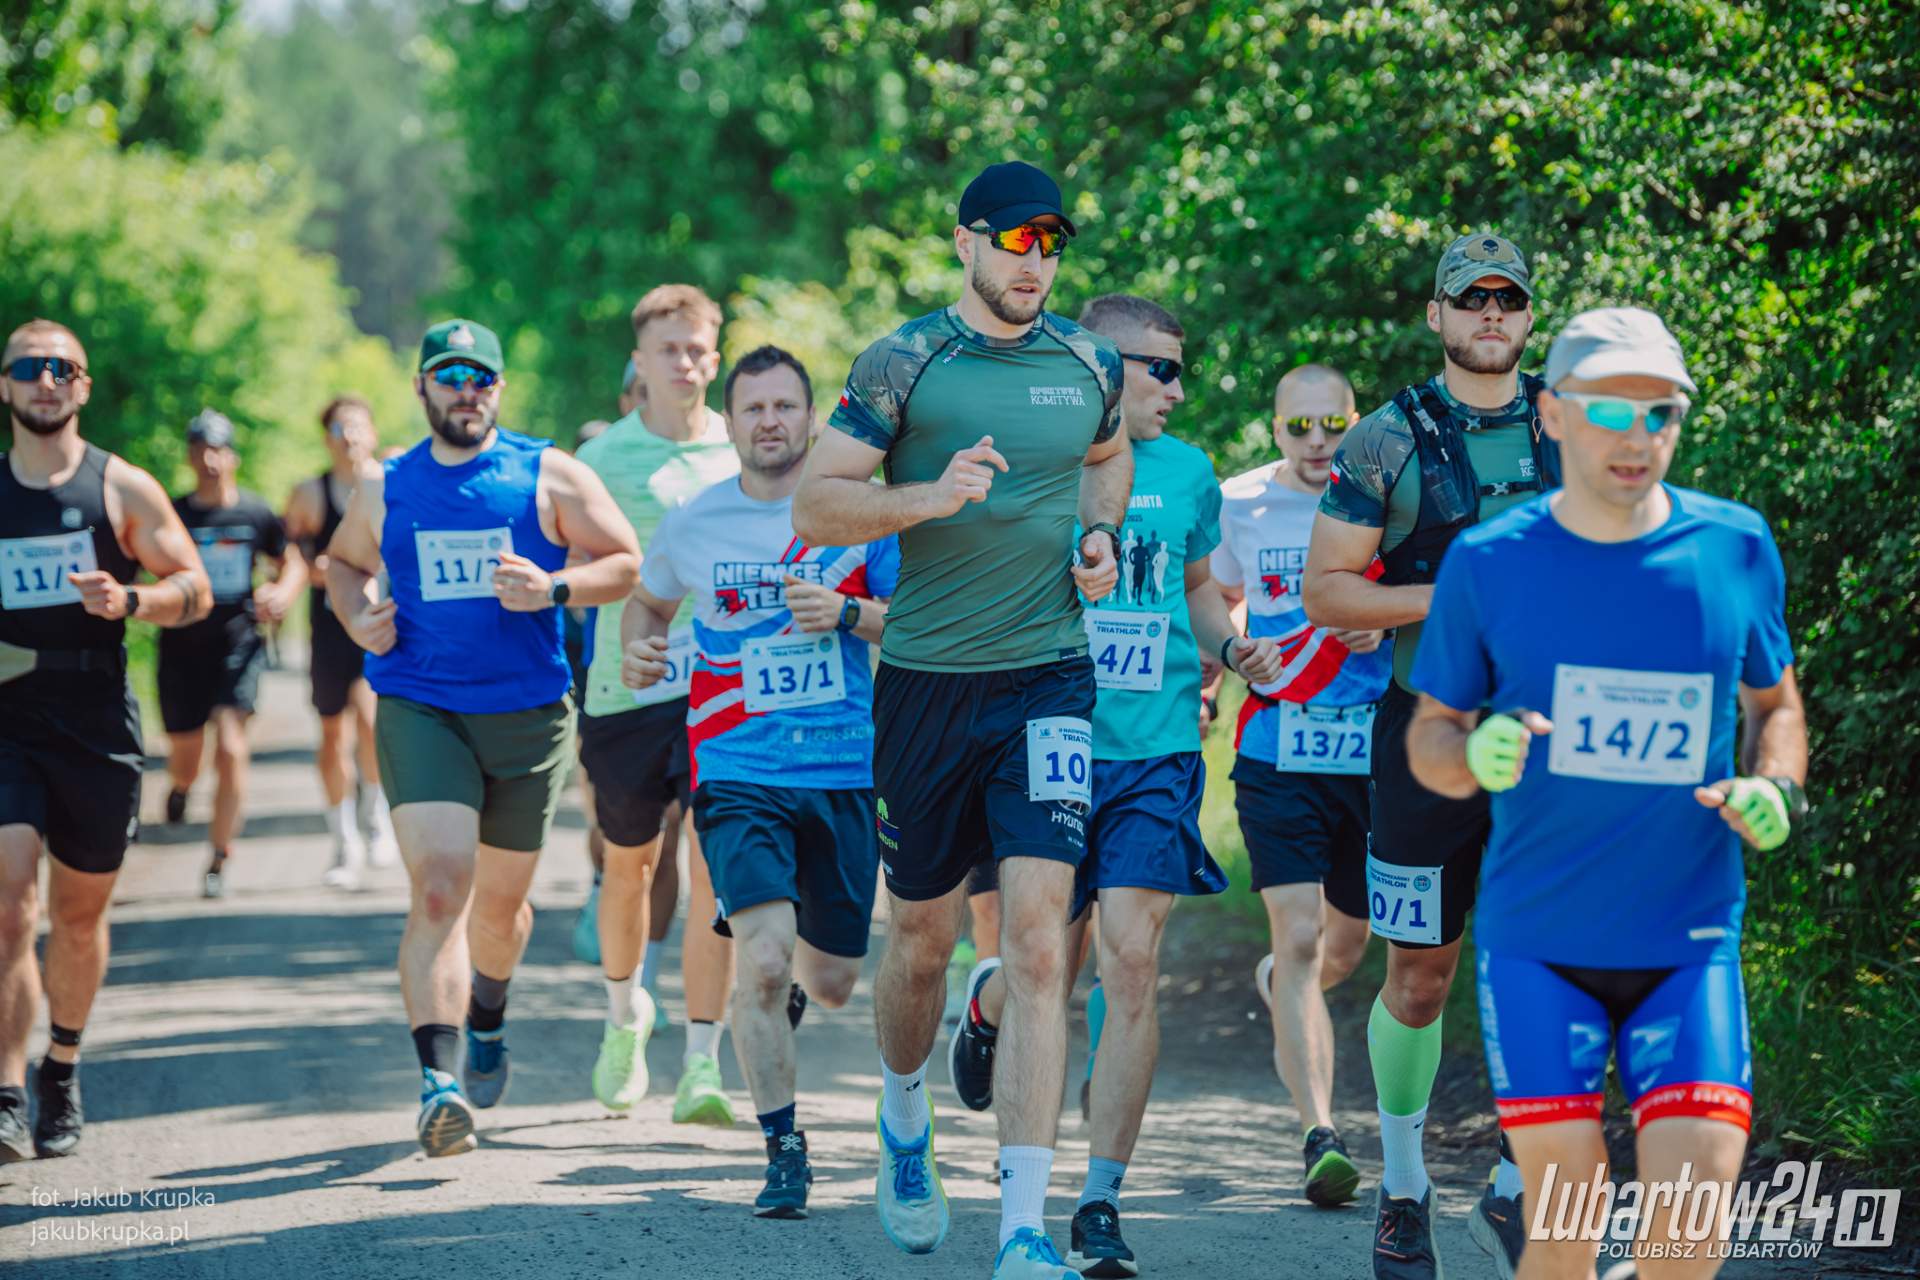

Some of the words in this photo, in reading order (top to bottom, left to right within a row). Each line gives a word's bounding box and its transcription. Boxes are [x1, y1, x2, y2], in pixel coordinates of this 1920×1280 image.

[741, 586, 787, 610] TE
[1097, 626, 1141, 635] TRIATHLON
[758, 660, 834, 696] 13/1
[1291, 730, 1367, 759] 13/2
[1574, 715, 1690, 761] 14/2
